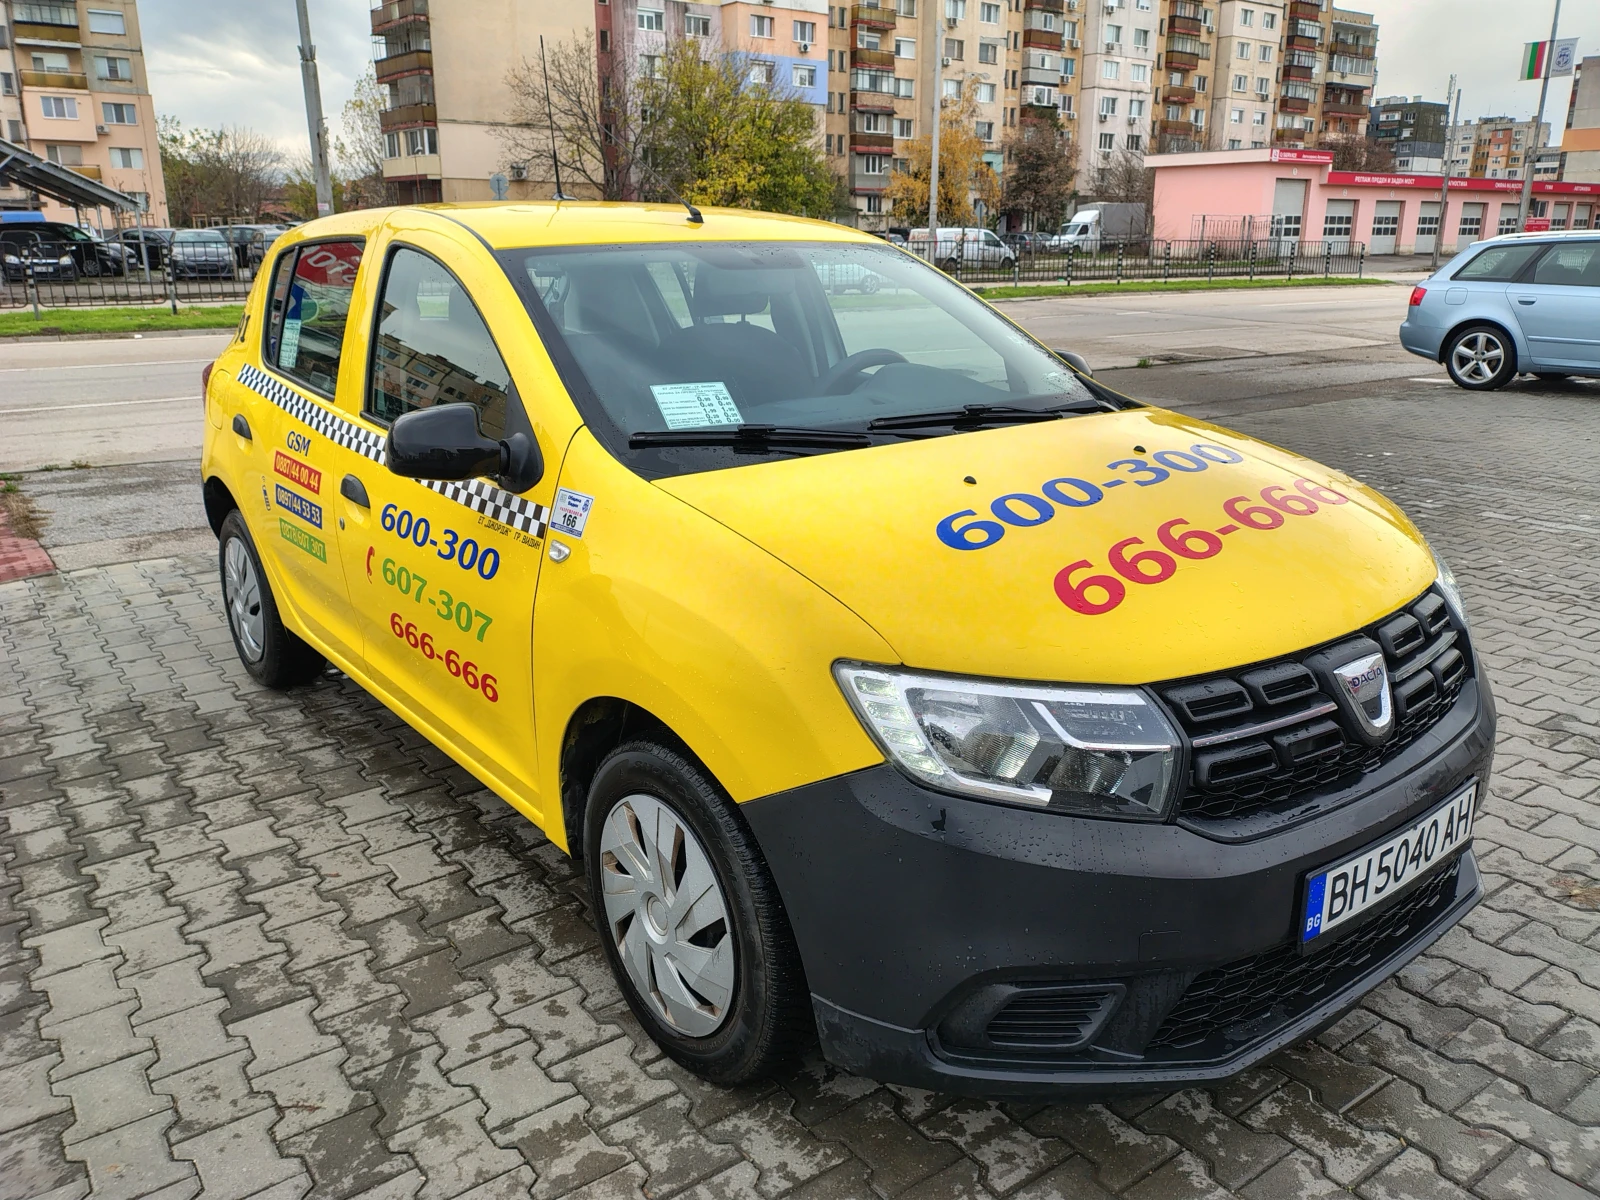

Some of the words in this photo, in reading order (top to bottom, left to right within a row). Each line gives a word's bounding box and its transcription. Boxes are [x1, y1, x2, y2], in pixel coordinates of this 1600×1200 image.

[287, 431, 311, 456] GSM
[300, 467, 308, 485] 00
[310, 472, 318, 490] 44
[936, 444, 1243, 551] 600-300
[302, 500, 310, 518] 53
[312, 507, 320, 525] 53
[562, 513, 578, 528] 166
[311, 538, 324, 558] 307
[381, 504, 500, 580] 600-300
[1054, 479, 1349, 615] 666-666
[382, 558, 493, 642] 607-307
[390, 612, 499, 702] 666-666
[1352, 667, 1384, 687] DACIA
[1328, 858, 1372, 922] BH
[1374, 818, 1439, 895] 5040
[1440, 792, 1472, 853] AH
[1306, 913, 1321, 932] BG
